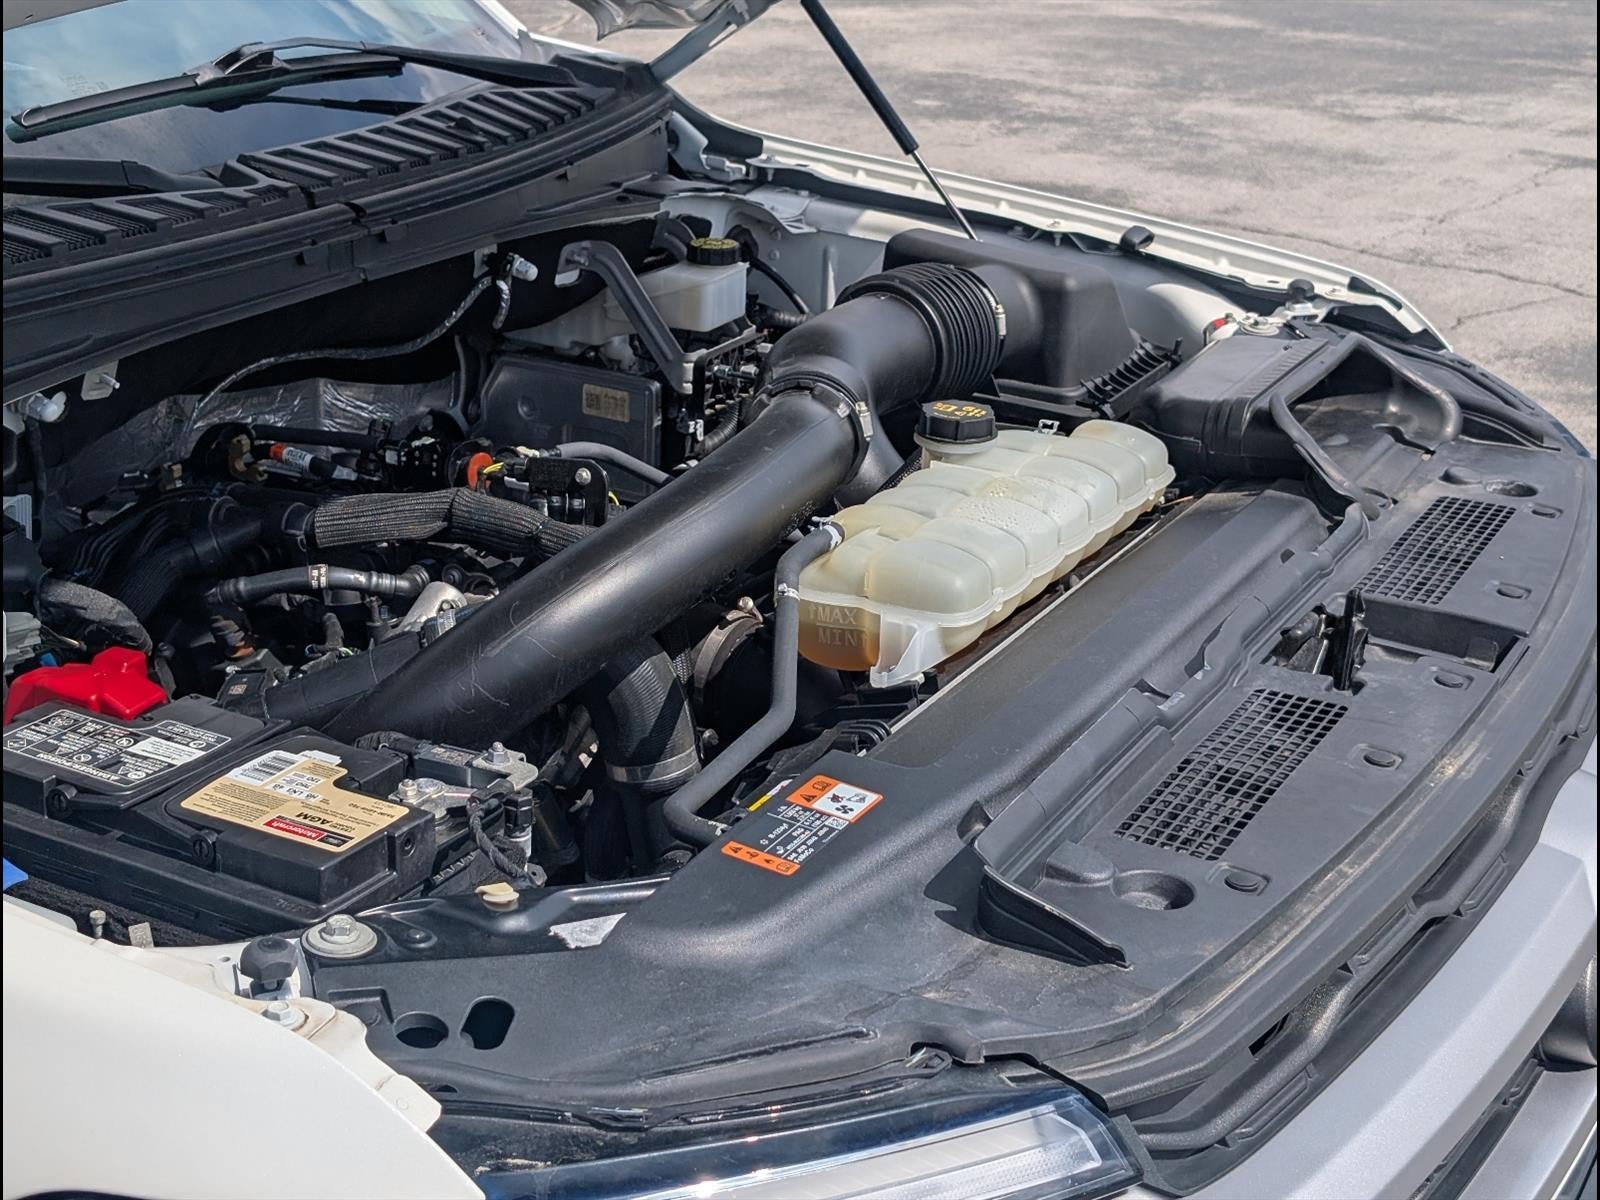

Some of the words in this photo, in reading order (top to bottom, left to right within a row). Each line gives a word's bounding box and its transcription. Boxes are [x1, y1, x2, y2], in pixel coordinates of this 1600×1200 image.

[817, 605, 857, 625] MAX
[817, 627, 858, 647] MIN
[296, 811, 333, 826] AGM
[270, 820, 320, 838] Motorcraft
